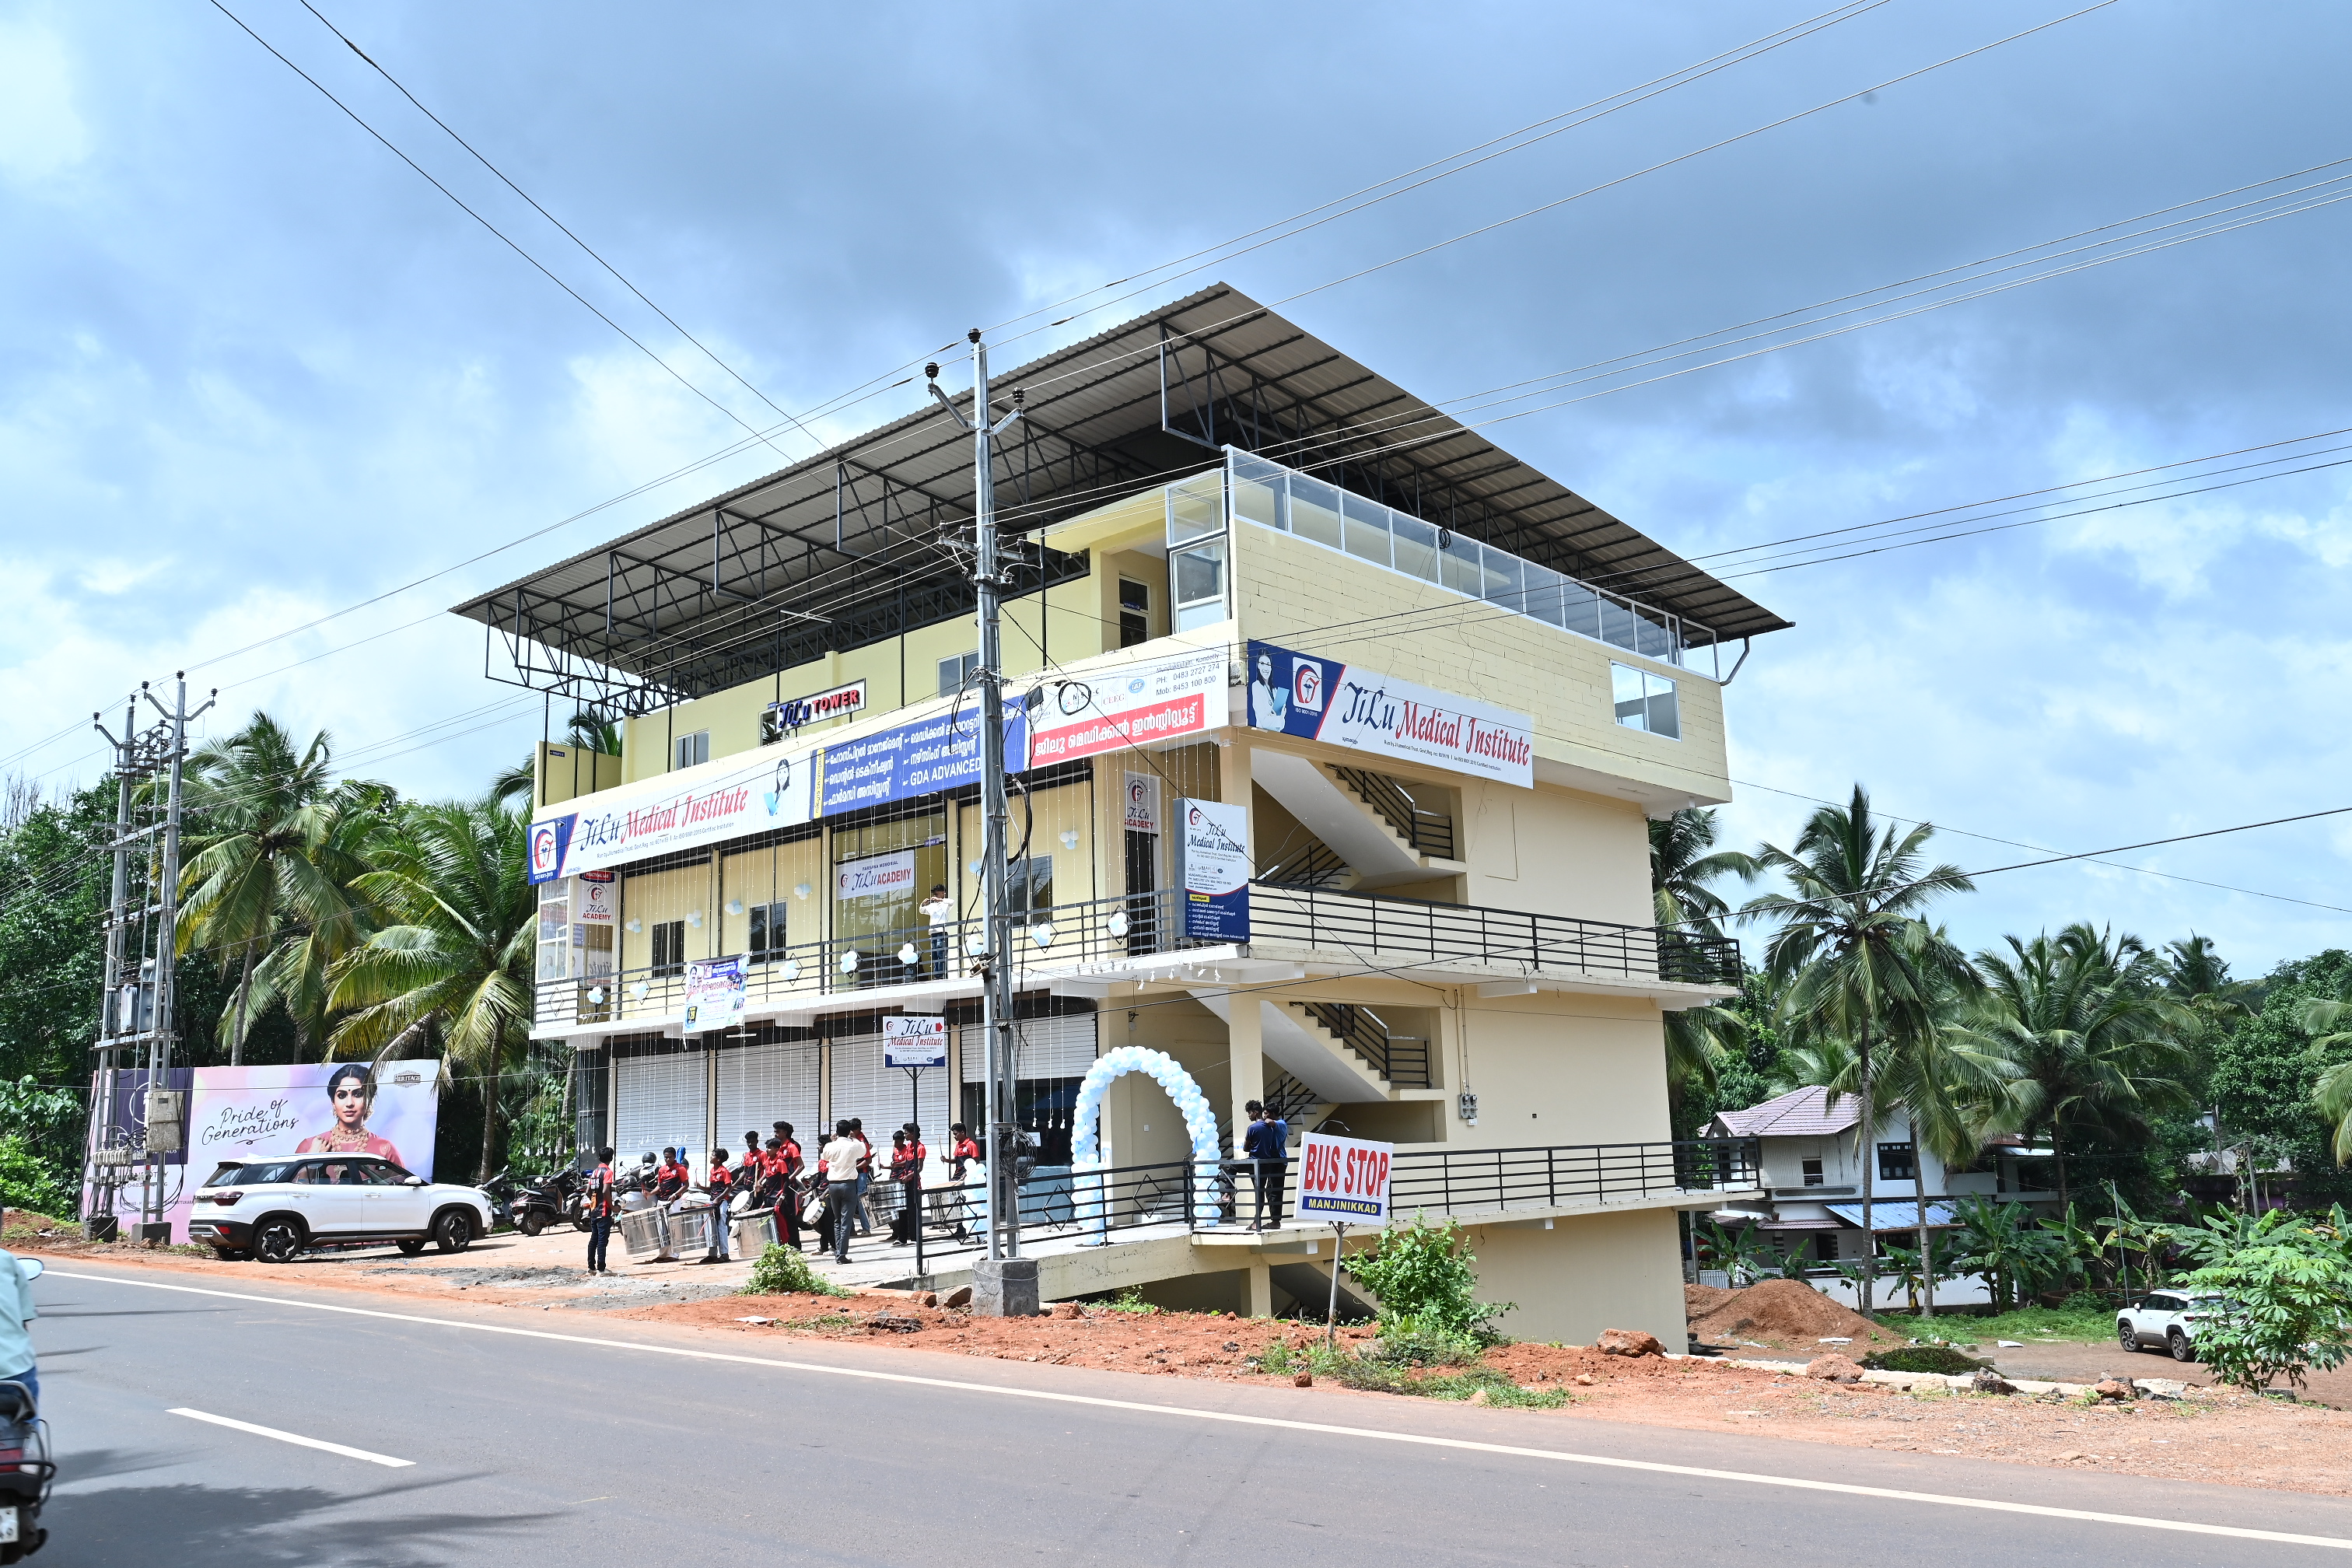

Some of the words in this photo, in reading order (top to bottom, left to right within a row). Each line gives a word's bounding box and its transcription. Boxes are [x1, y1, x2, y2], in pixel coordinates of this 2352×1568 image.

[1156, 676, 1167, 684] PH:
[1173, 670, 1188, 680] 0483
[1190, 666, 1206, 676] 2727
[1208, 663, 1220, 672] 274
[1156, 687, 1171, 695] Mob:
[1173, 682, 1188, 691] 8453
[1191, 678, 1202, 688] 100
[1204, 675, 1216, 684] 800
[812, 689, 860, 714] TOWER
[1035, 737, 1066, 757] ജിലു
[1068, 719, 1130, 749] മെഡിക്കൽ
[1395, 700, 1462, 749] Medical
[1466, 717, 1530, 766] Institute
[910, 768, 929, 786] GDA
[931, 757, 982, 781] ADVANCED
[621, 800, 678, 844] Medical
[682, 786, 748, 828] Institute
[1125, 817, 1154, 829] ACADEMY
[1187, 834, 1215, 849] Medical
[1216, 838, 1245, 853] Institute
[880, 860, 898, 869] MEMORIAL
[877, 868, 912, 886] ACADEMY
[583, 912, 611, 921] ACADEMY
[887, 1035, 915, 1048] Medical
[915, 1035, 943, 1047] Institute
[220, 1106, 268, 1129] Pride
[270, 1099, 289, 1118] of
[201, 1118, 299, 1145] Generations
[1304, 1143, 1342, 1193] BUS
[1344, 1147, 1389, 1199] STOP
[1307, 1199, 1377, 1214] MANJINIKKAD
